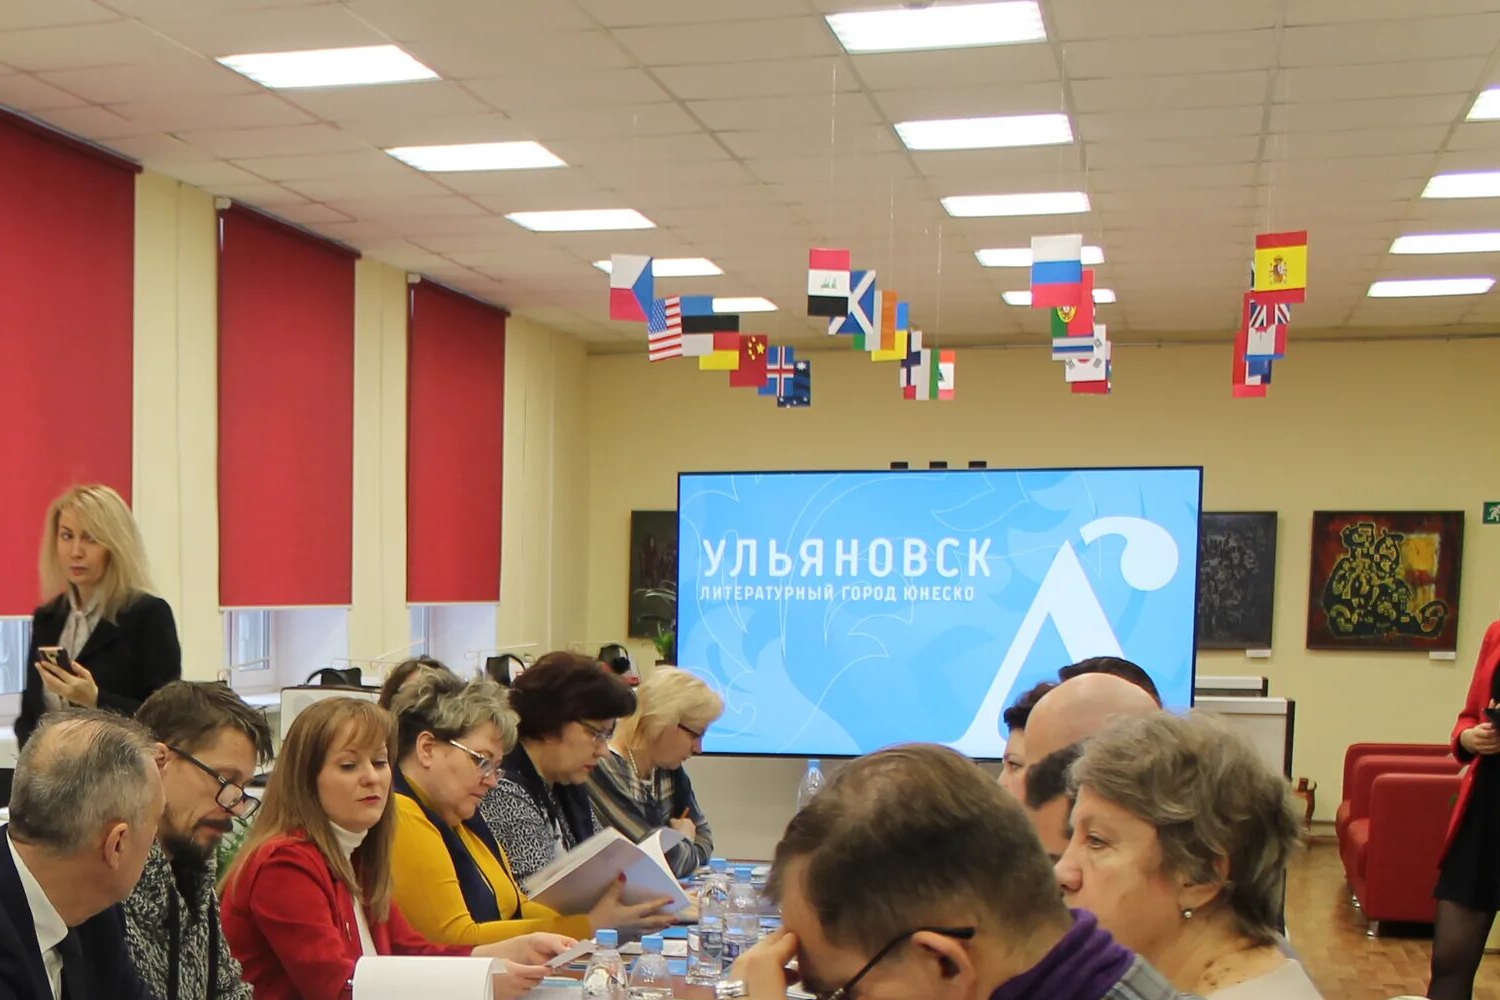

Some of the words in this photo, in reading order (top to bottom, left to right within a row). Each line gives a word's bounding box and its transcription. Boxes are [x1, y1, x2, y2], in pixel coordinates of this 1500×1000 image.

[702, 537, 992, 578] УЛЬЯНОВСК
[699, 583, 834, 601] ЛИТЕРАТУРНЫЙ
[841, 585, 898, 602] ГОРОД
[903, 585, 975, 601] ЮНЕСКО
